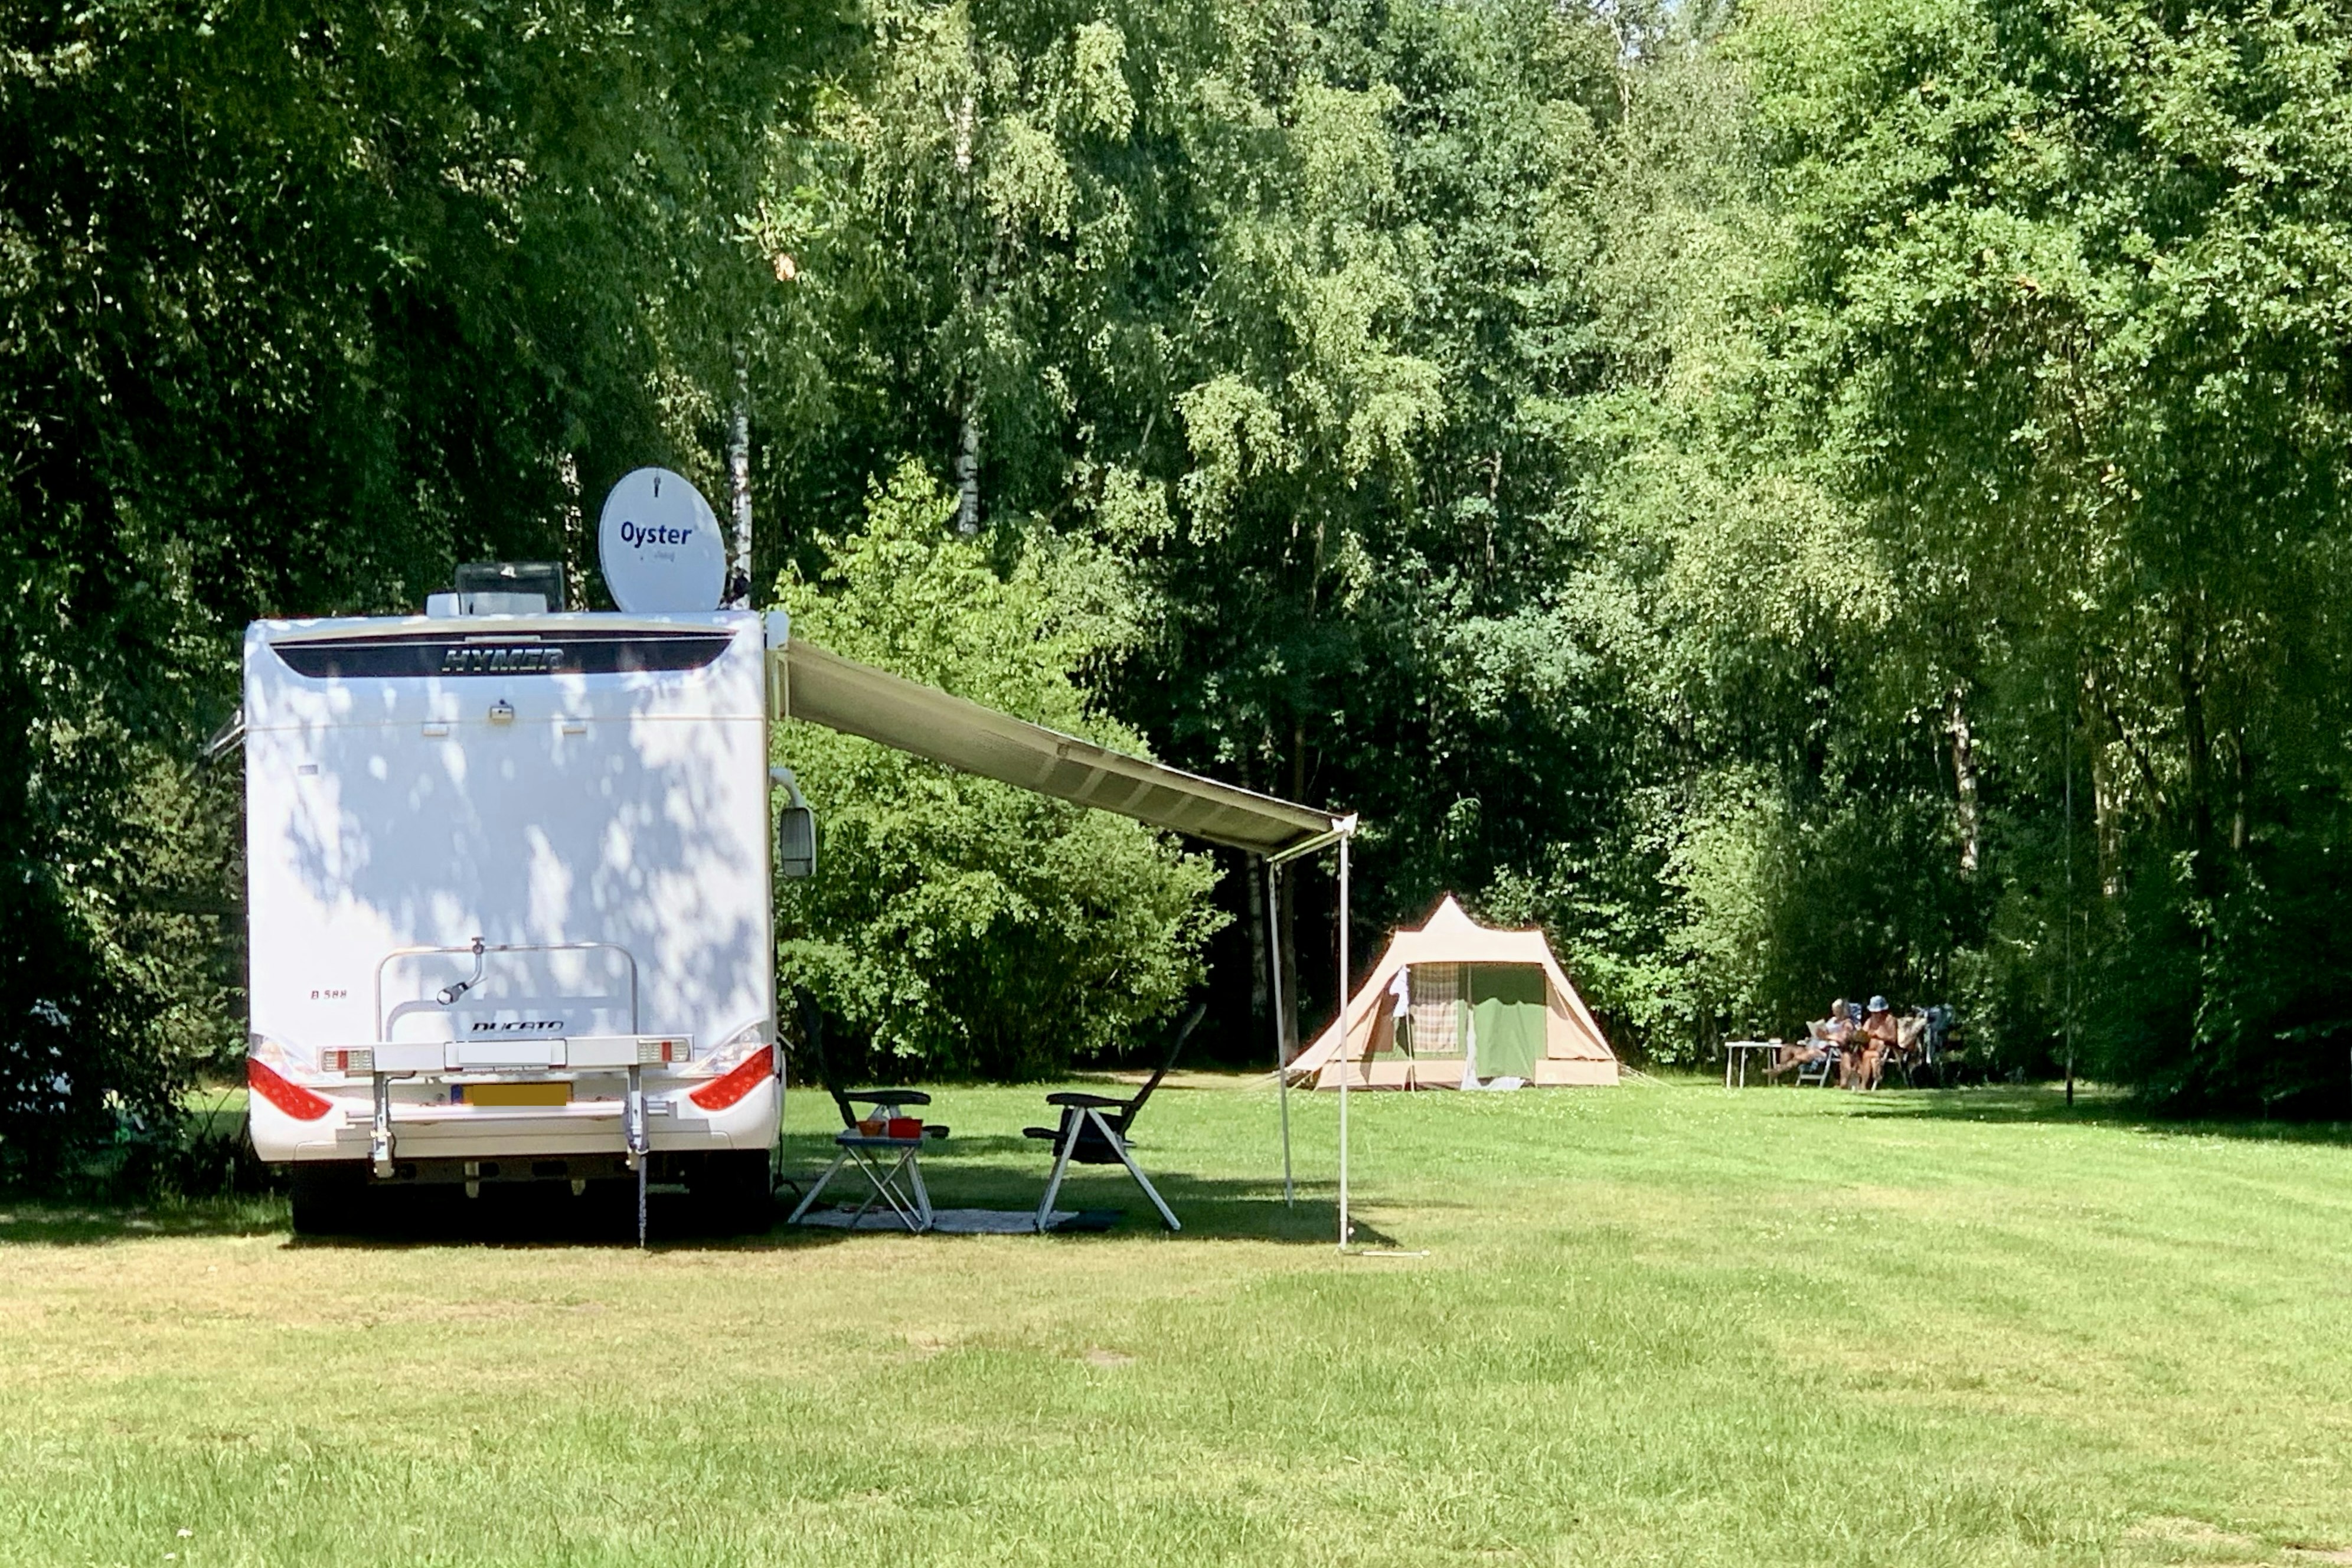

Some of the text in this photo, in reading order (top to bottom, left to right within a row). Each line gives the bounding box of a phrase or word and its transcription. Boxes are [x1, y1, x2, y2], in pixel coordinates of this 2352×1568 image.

[621, 521, 692, 548] Oyster
[442, 649, 564, 671] HYMER
[472, 1021, 564, 1032] DUCATO
